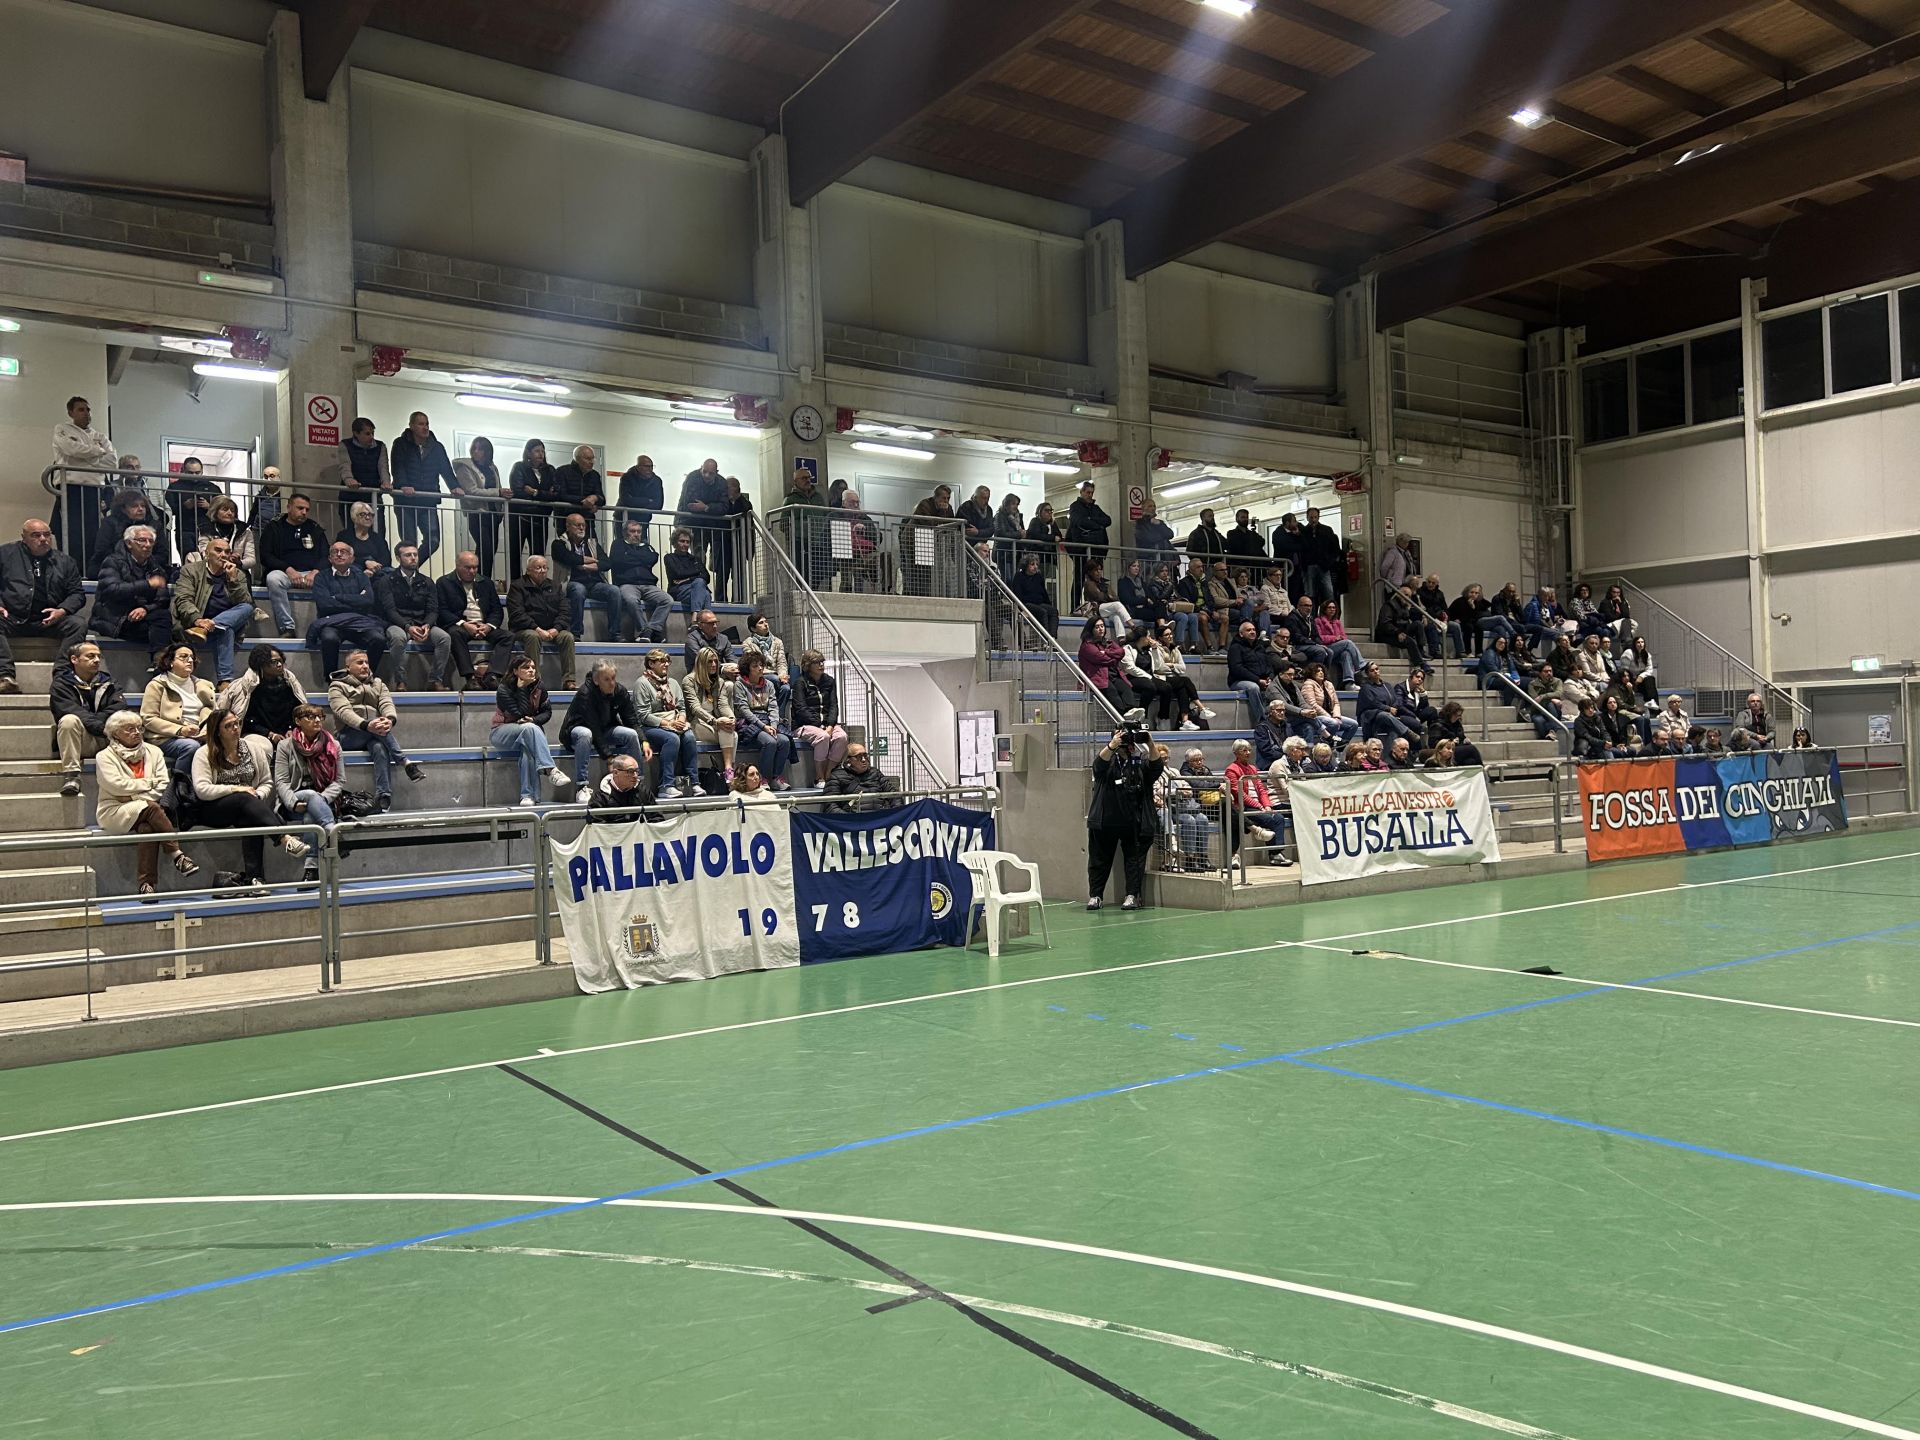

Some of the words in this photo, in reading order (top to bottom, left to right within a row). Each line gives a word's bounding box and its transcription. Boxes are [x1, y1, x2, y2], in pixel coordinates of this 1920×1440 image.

[311, 435, 336, 443] FUMARE
[312, 427, 336, 435] VIETATO
[1589, 787, 1677, 831] FOSSA
[1677, 785, 1720, 821] DEI
[1724, 774, 1836, 820] CINGHIALI
[1317, 809, 1473, 860] BUSALLA
[568, 831, 776, 903] PALLAVOLO
